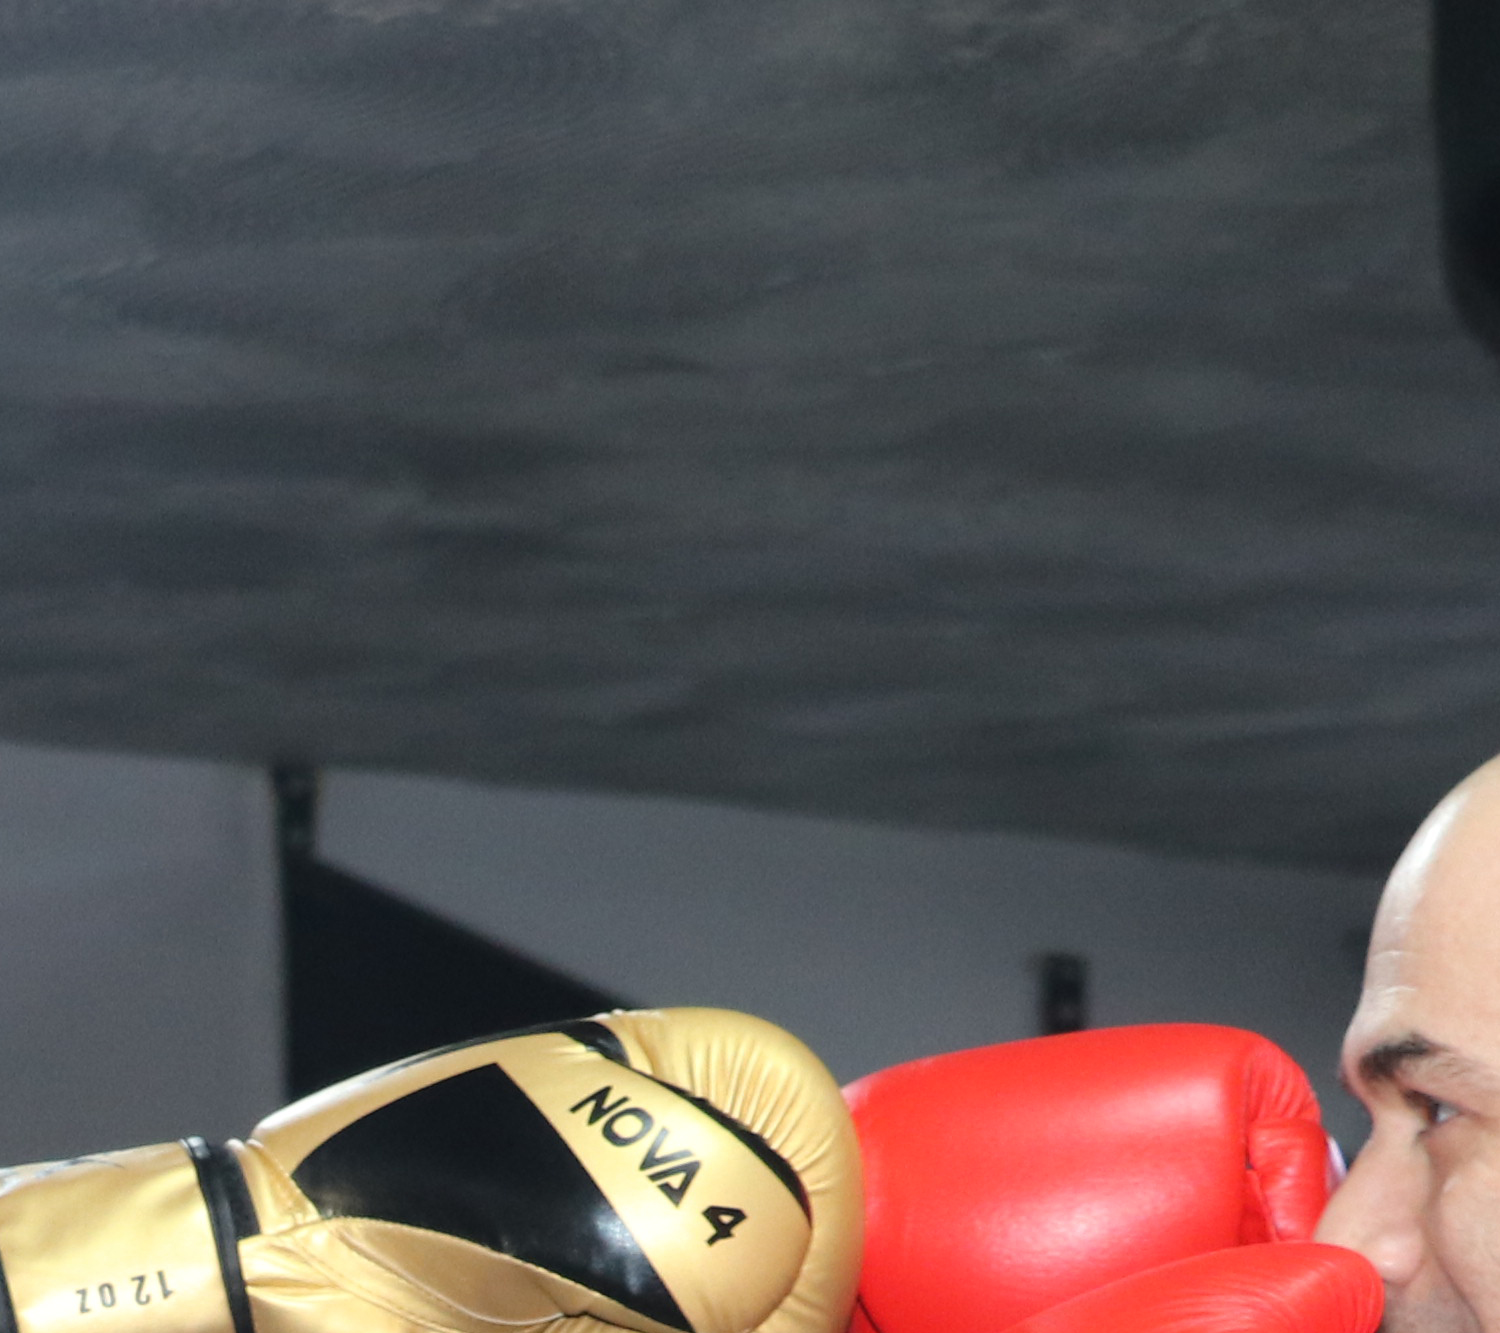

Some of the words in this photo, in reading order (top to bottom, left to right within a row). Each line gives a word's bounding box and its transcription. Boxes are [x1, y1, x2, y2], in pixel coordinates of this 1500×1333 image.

[569, 1085, 702, 1208] NOVA
[702, 1205, 748, 1247] 4
[131, 1270, 175, 1306] 12
